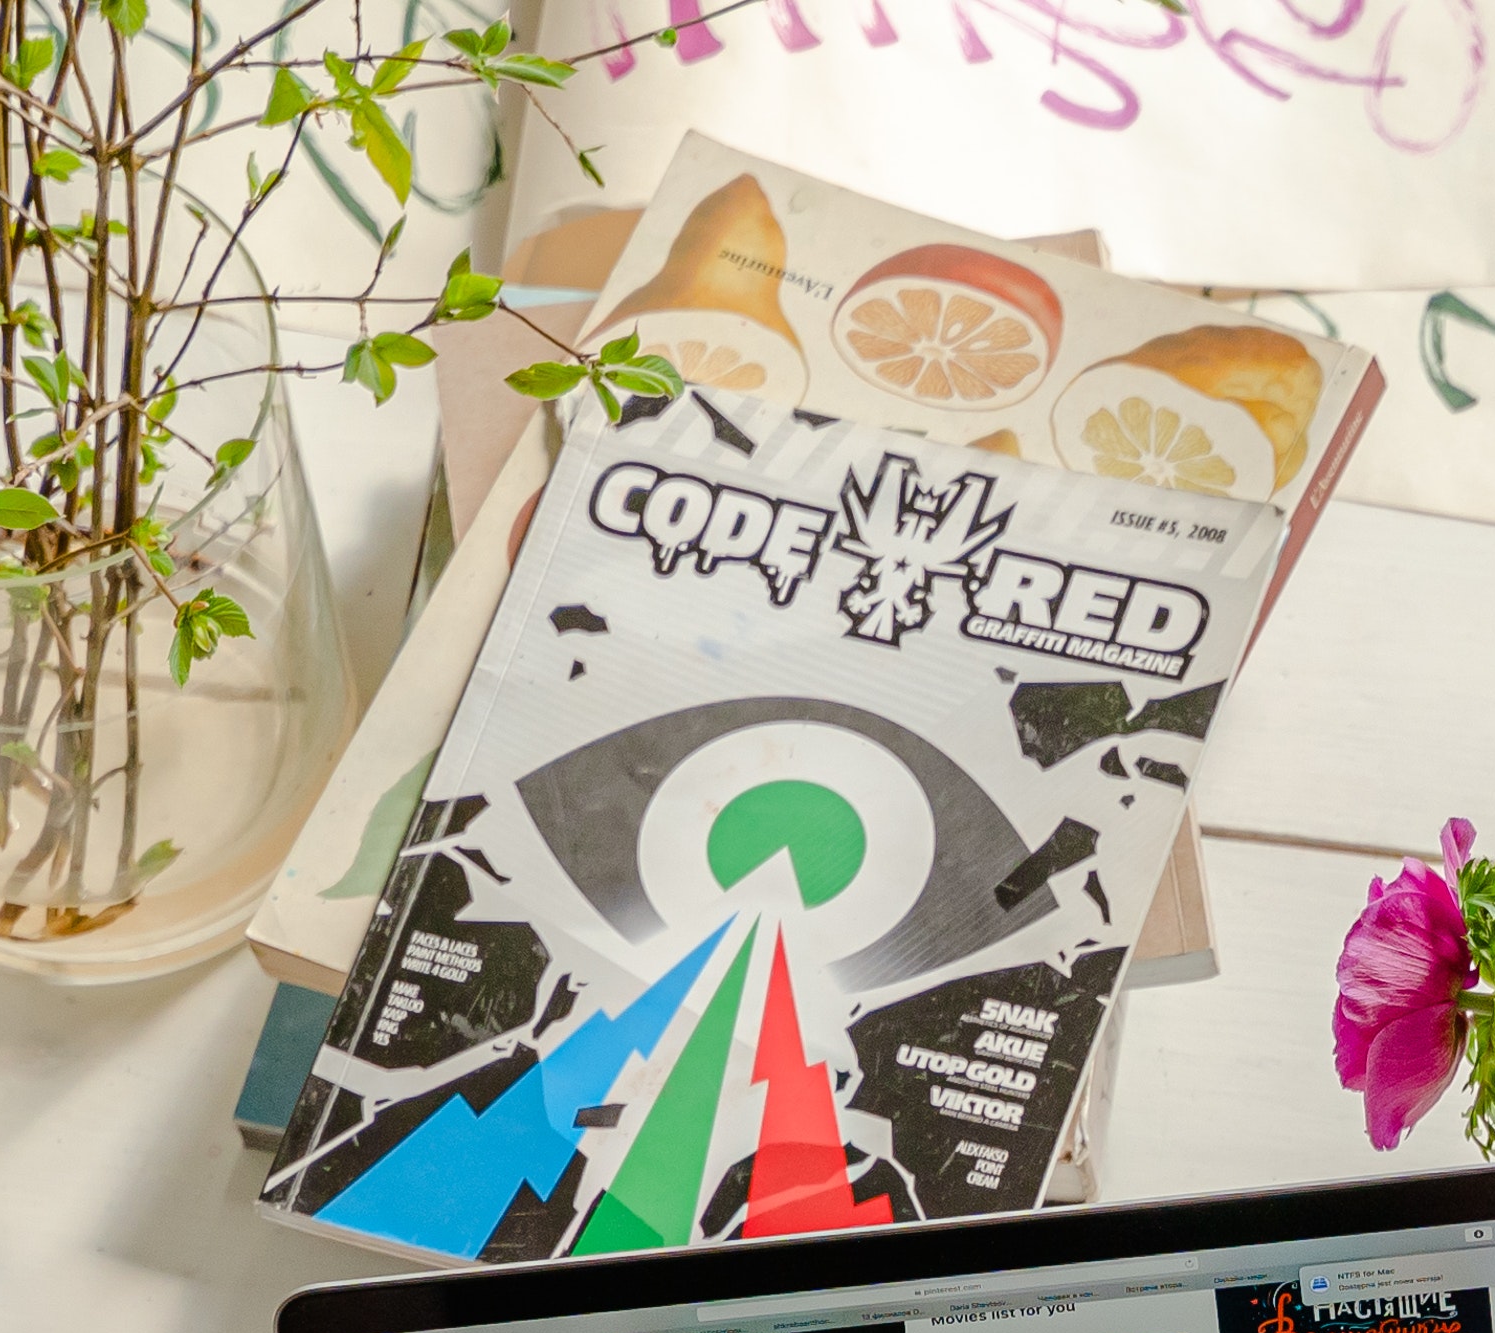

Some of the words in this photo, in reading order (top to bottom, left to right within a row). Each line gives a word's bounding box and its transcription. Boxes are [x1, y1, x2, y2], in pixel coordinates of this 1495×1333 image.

[718, 249, 834, 300] L'Aventurine
[1110, 509, 1155, 531] ISSUE
[1188, 524, 1229, 544] 2008
[589, 461, 836, 606] CODE
[976, 549, 1209, 655] RED
[966, 616, 1066, 653] GRAFFITI
[1066, 635, 1185, 678] MAGAZINE
[449, 938, 479, 958] LACES
[439, 967, 468, 983] GOLD
[974, 1030, 1048, 1063] AKUE
[896, 1043, 968, 1076] UTOP
[965, 1060, 1037, 1092] GOLD
[930, 1085, 1024, 1125] VIKTOR
[924, 1282, 982, 1296] pinterest.com
[1363, 1270, 1375, 1278] for
[1378, 1268, 1395, 1276] Mac
[1048, 1302, 1076, 1318] you
